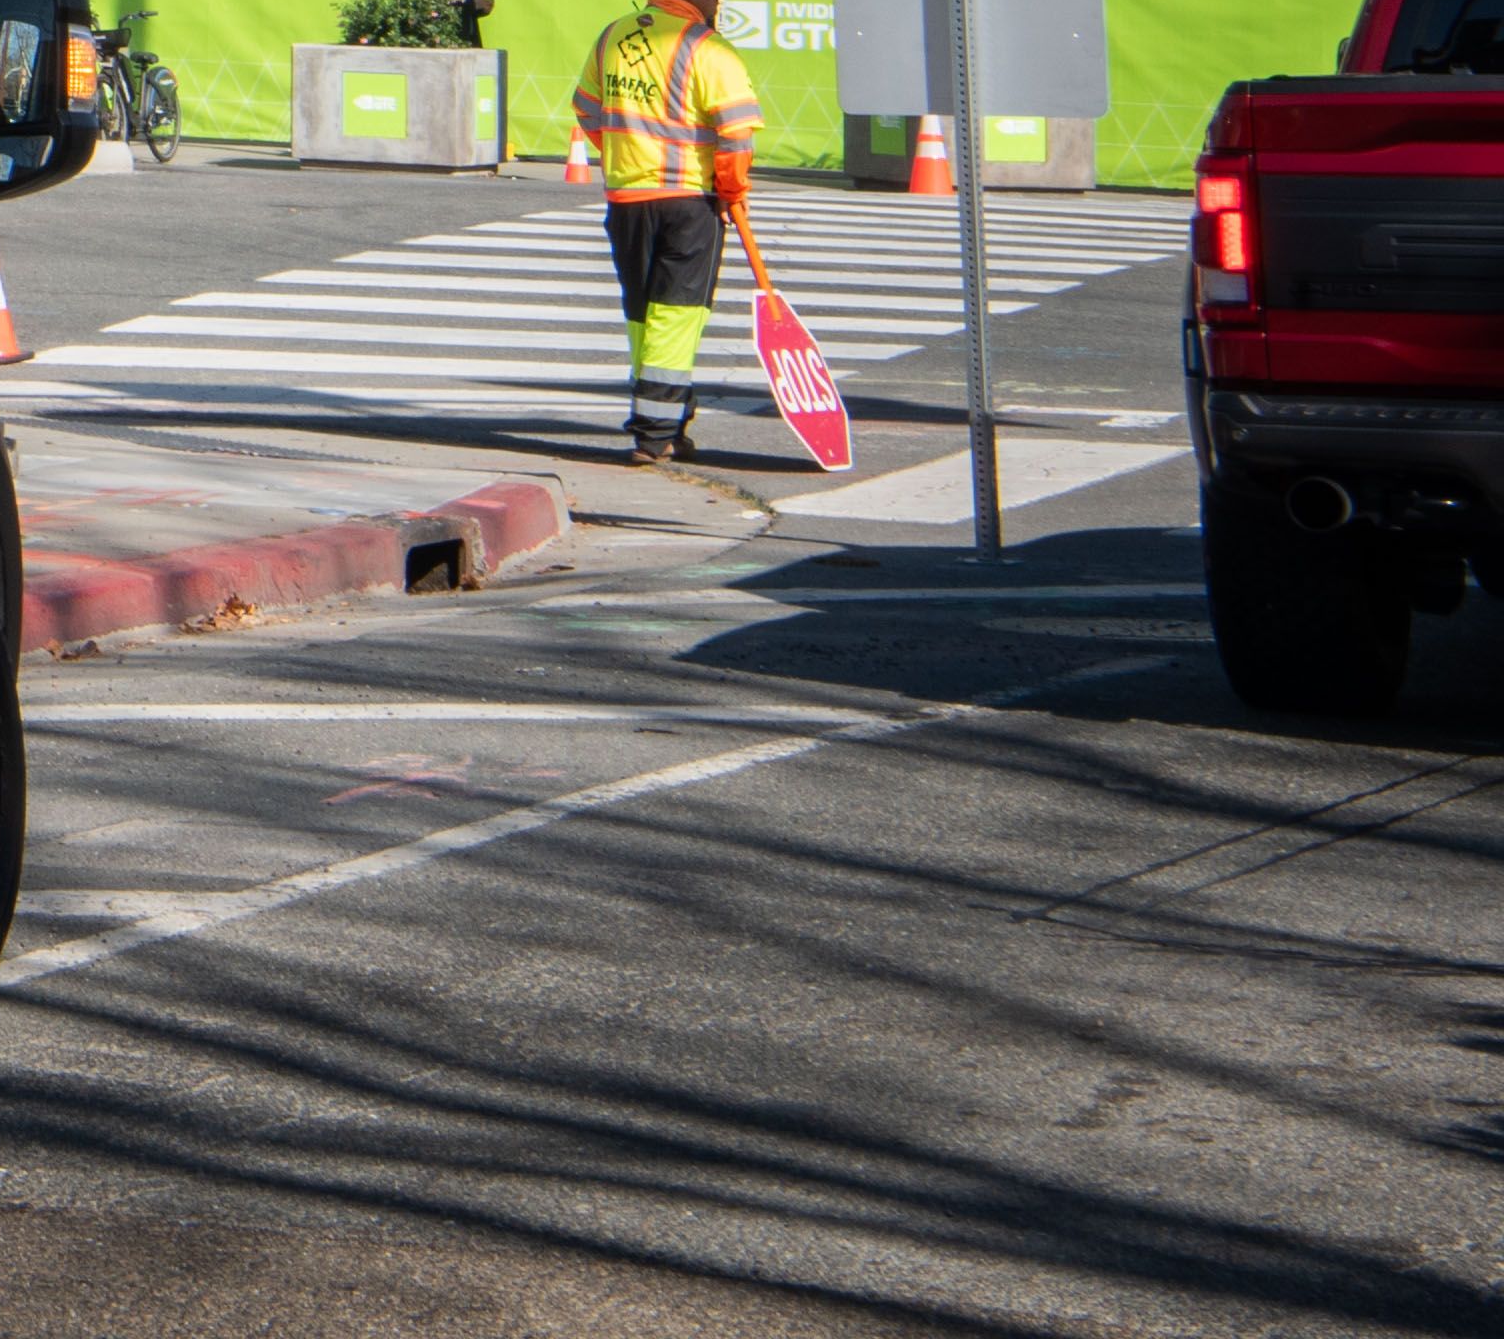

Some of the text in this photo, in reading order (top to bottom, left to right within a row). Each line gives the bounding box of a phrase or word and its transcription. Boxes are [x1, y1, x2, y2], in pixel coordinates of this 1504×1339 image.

[775, 2, 835, 20] NVIDI
[774, 21, 836, 52] GT
[771, 348, 837, 414] STOP
